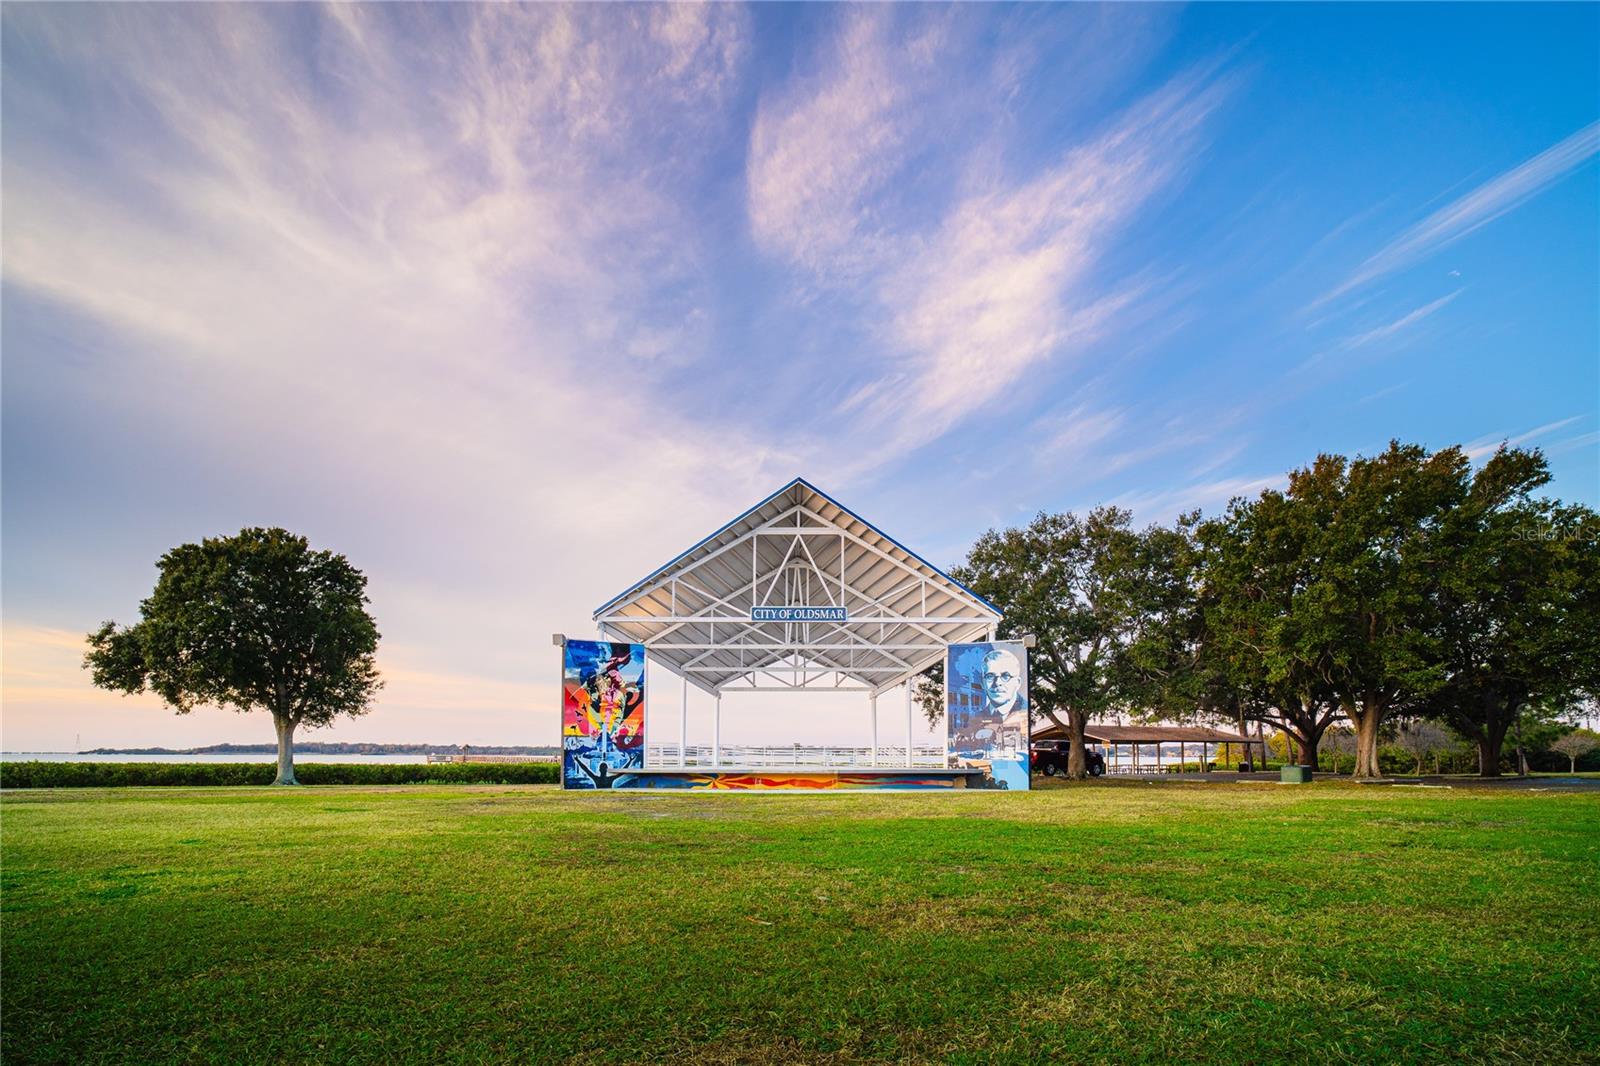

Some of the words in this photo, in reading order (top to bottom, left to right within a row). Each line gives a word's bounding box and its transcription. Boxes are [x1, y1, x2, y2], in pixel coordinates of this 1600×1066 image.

[753, 609, 778, 619] CITY
[779, 609, 792, 619] OF
[794, 609, 844, 619] OLDSMAR
